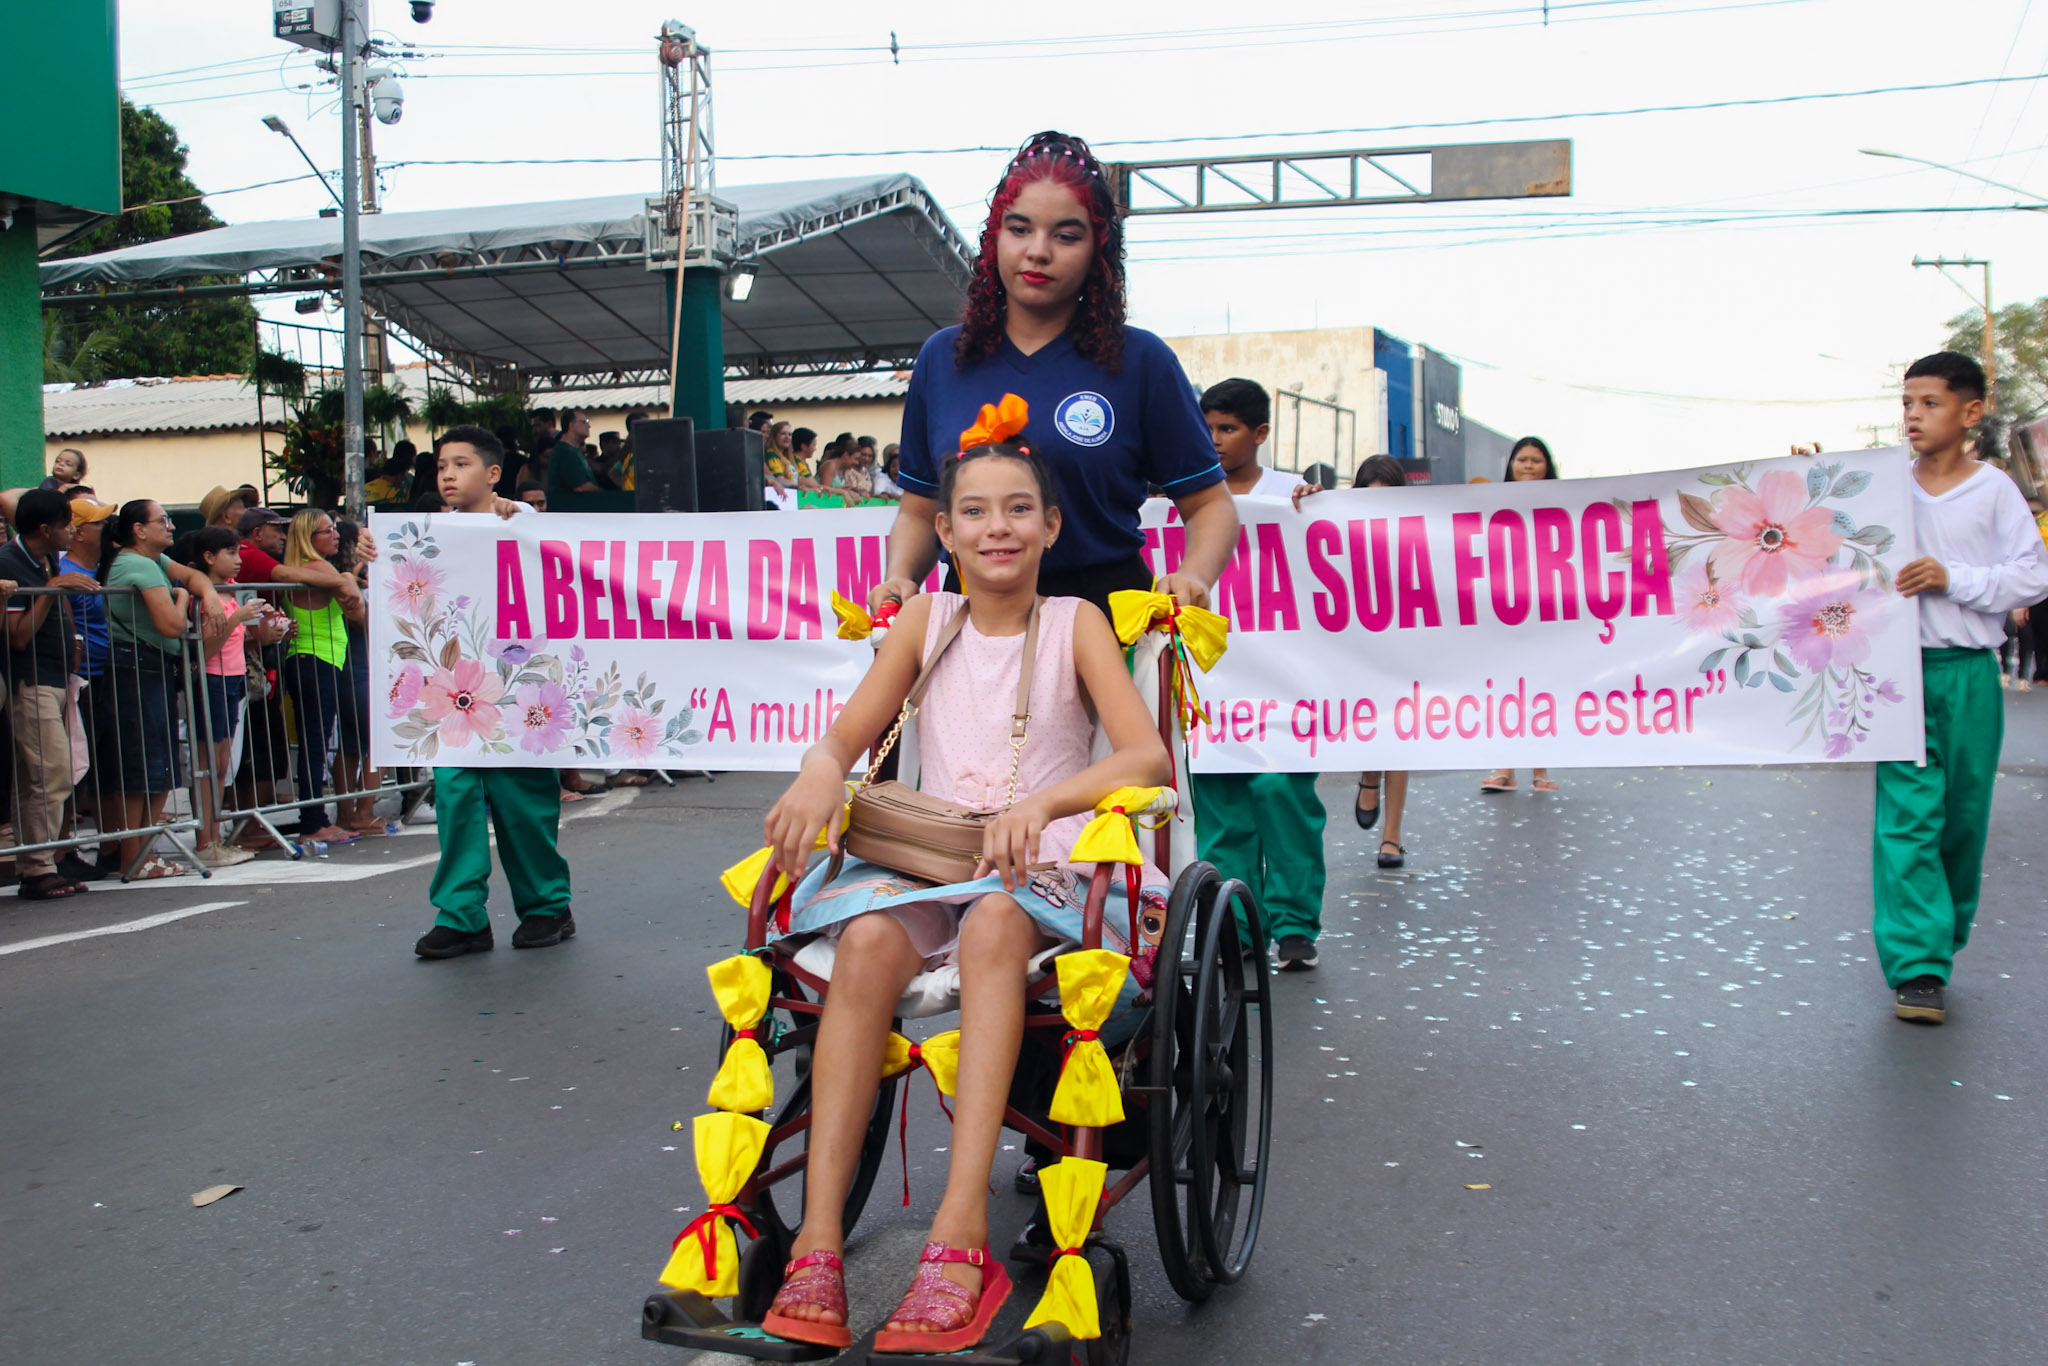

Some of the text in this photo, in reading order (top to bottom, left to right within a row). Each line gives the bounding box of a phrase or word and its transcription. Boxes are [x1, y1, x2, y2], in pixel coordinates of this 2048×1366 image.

[497, 540, 533, 639] A
[540, 540, 733, 640] BELEZA
[747, 538, 823, 640] DA
[1219, 523, 1301, 632] NA
[1306, 515, 1442, 632] SUA
[1452, 499, 1675, 644] FORÇA
[750, 688, 845, 743] mulh
[1291, 697, 1378, 758] que
[1394, 677, 1558, 741] decida
